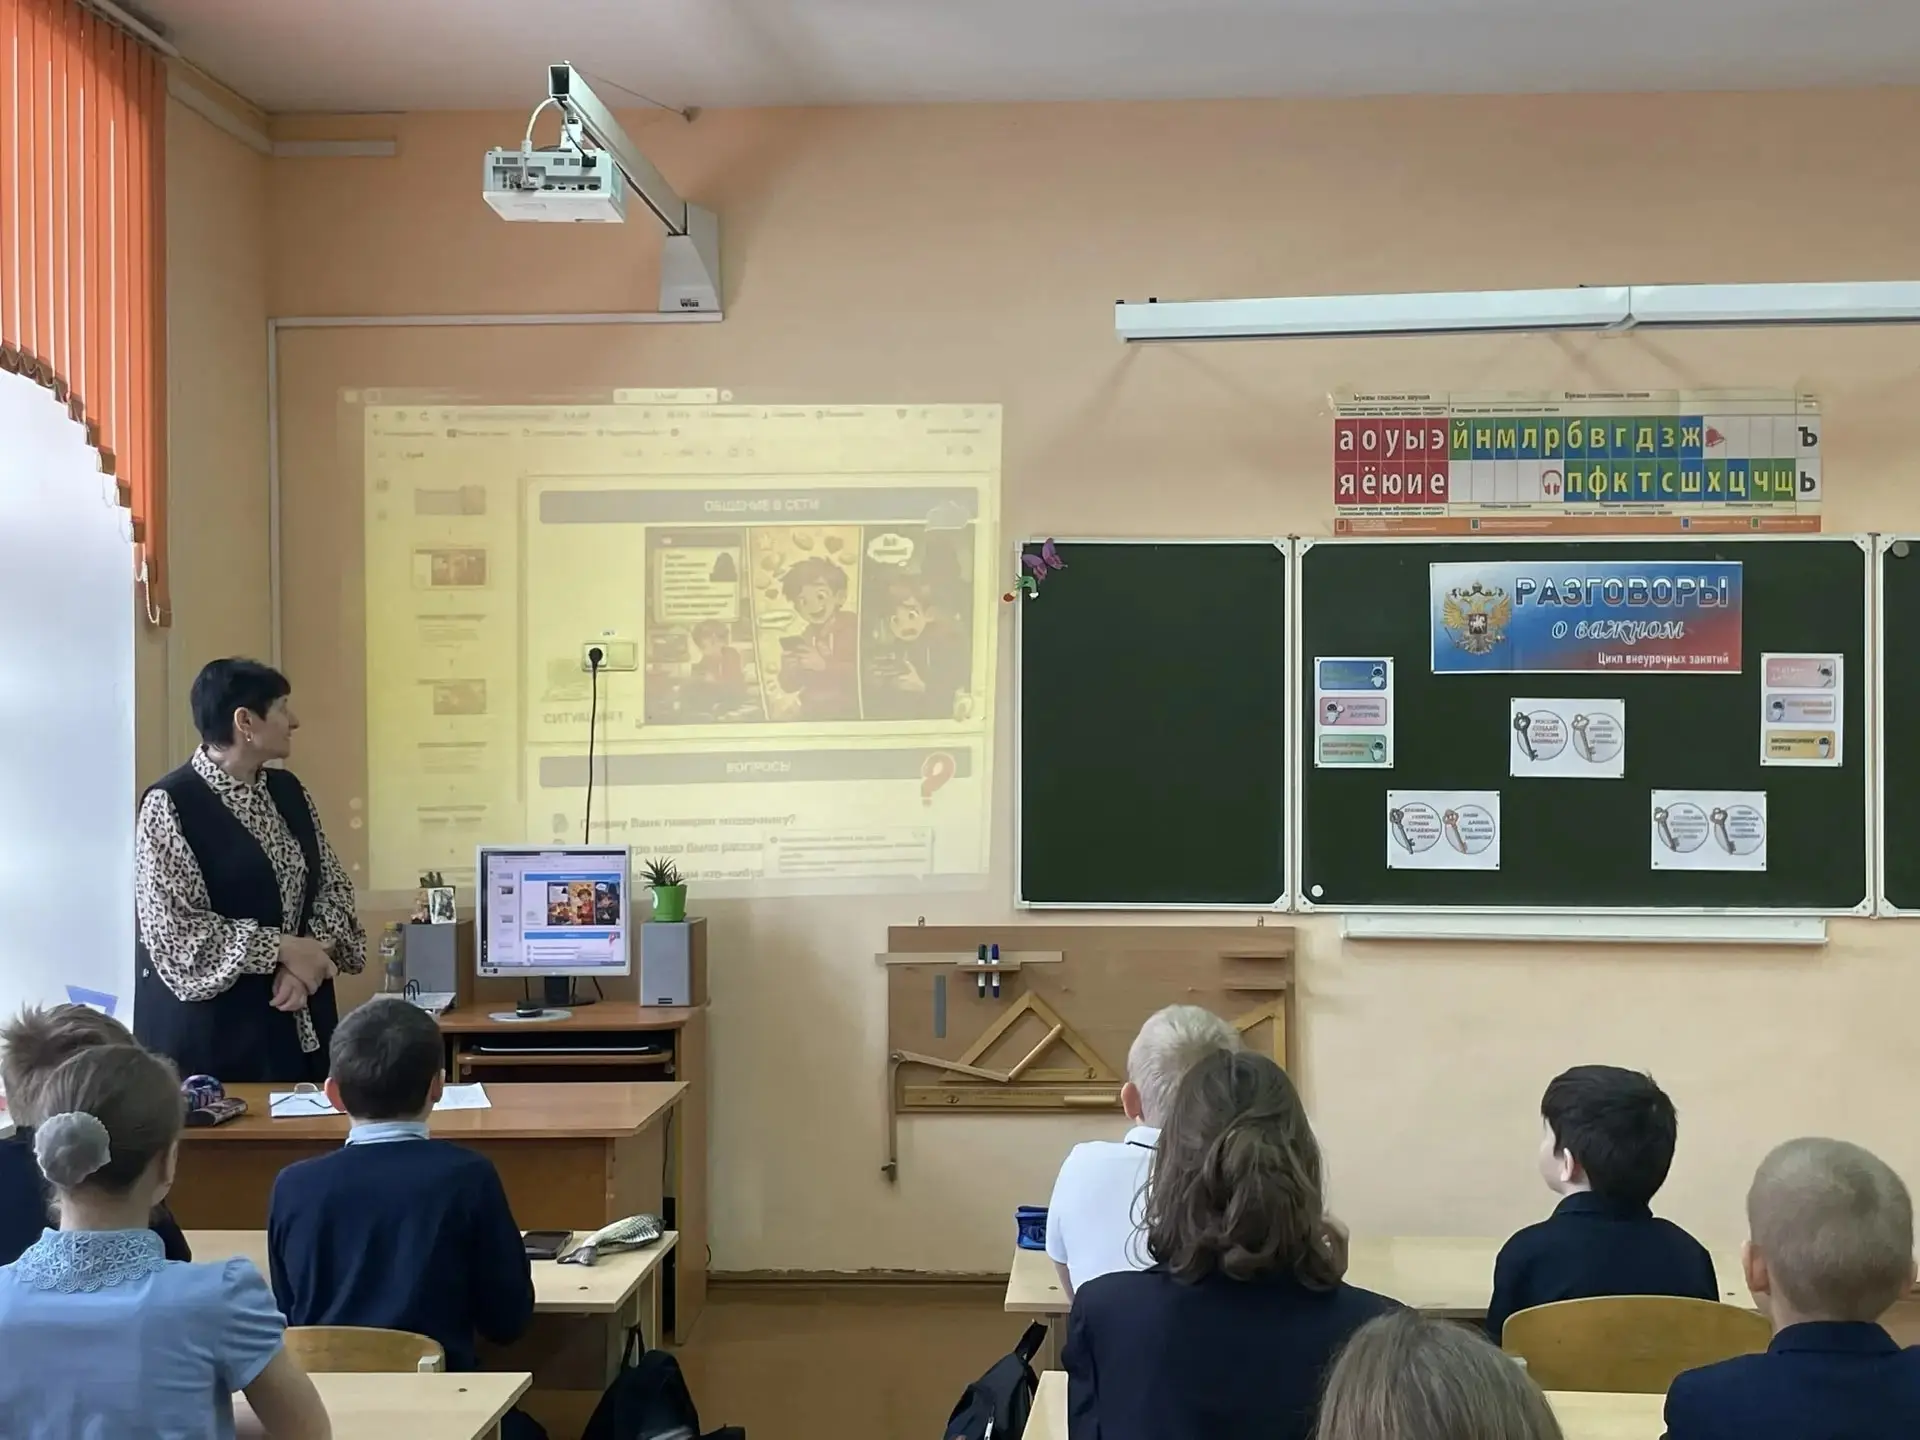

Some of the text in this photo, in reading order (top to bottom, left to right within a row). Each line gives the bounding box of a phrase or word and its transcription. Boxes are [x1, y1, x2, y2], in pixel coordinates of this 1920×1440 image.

[785, 498, 820, 512] СЕТИ
[1514, 575, 1730, 608] РАЗГОВОРЫ
[1551, 619, 1687, 646] о важном
[1598, 651, 1730, 669] Цикл внеурочных занятий
[726, 761, 793, 774] ВОПРОСЫ
